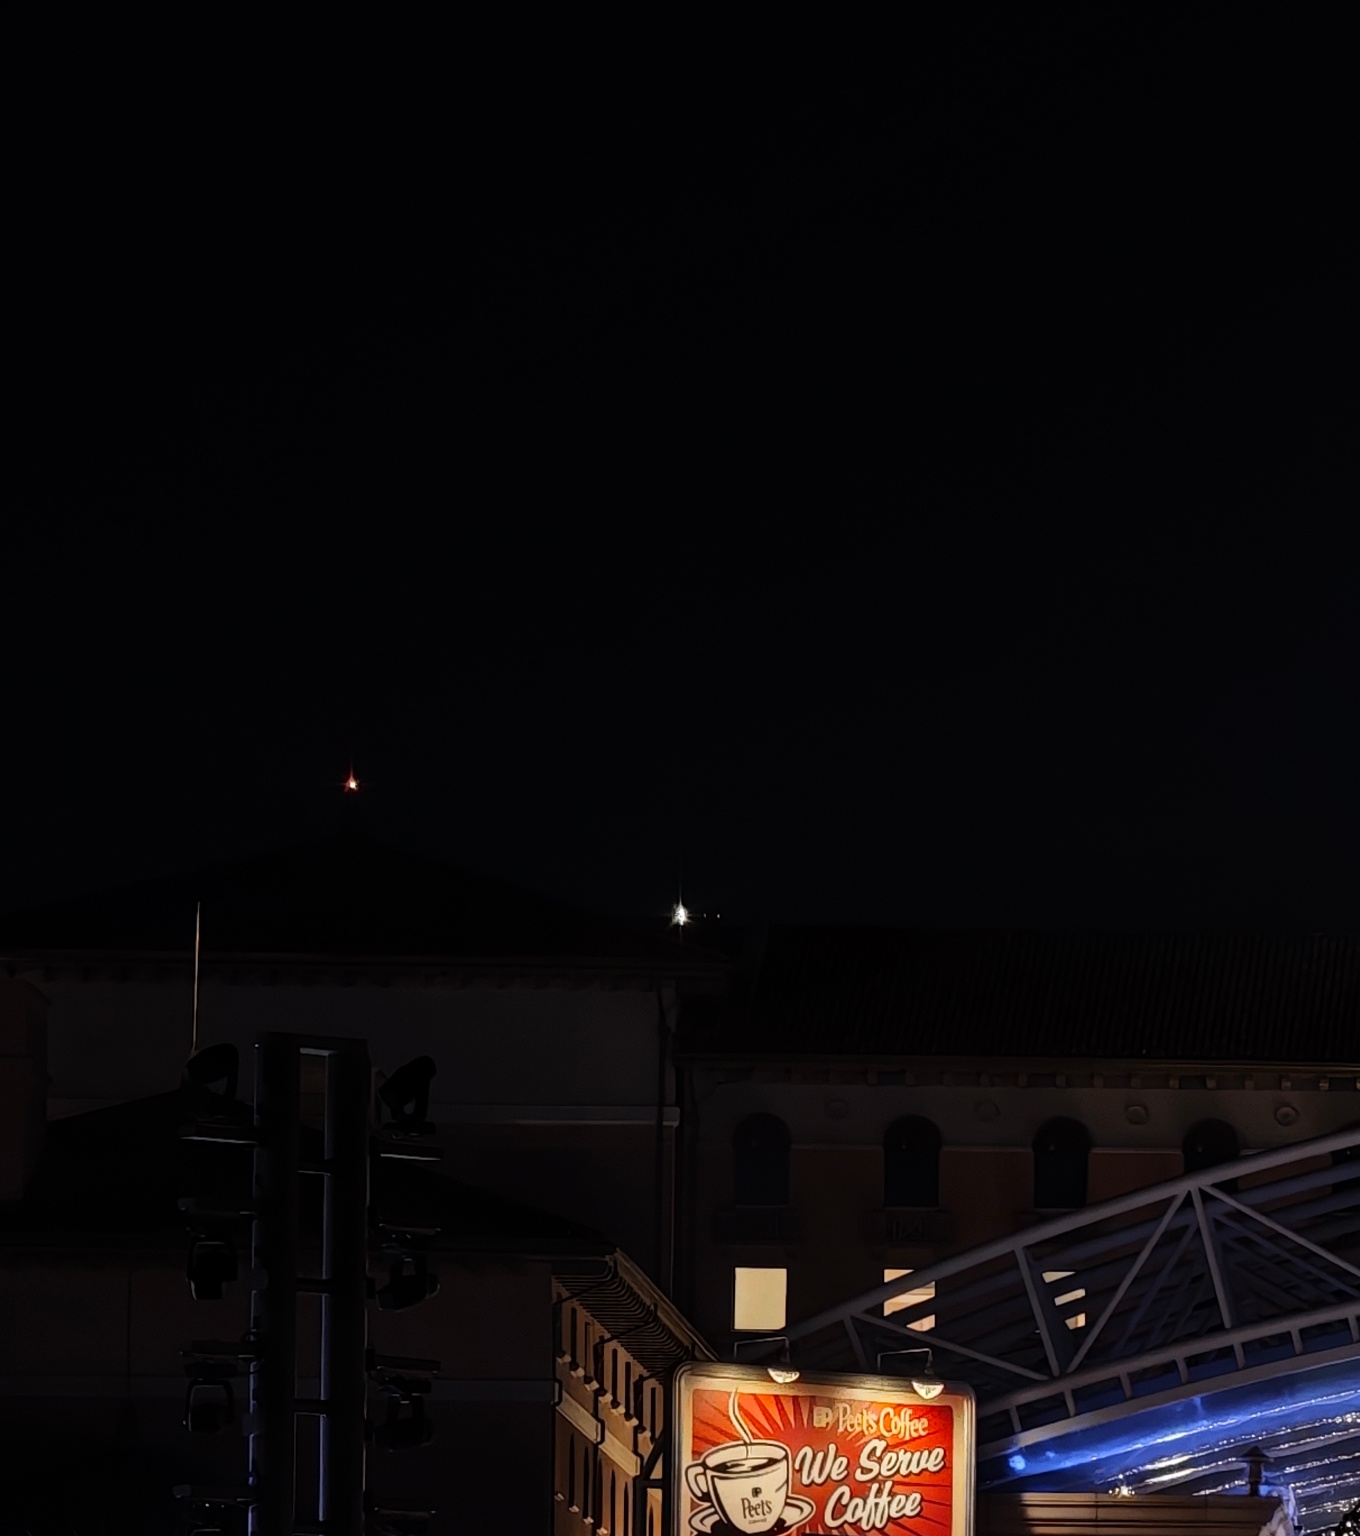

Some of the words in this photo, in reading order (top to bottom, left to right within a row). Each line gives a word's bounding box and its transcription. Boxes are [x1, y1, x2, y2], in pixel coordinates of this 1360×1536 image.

[879, 1406, 930, 1440] Coffee
[794, 1443, 849, 1486] We
[854, 1438, 946, 1483] Serve
[823, 1480, 923, 1532] Coffee
